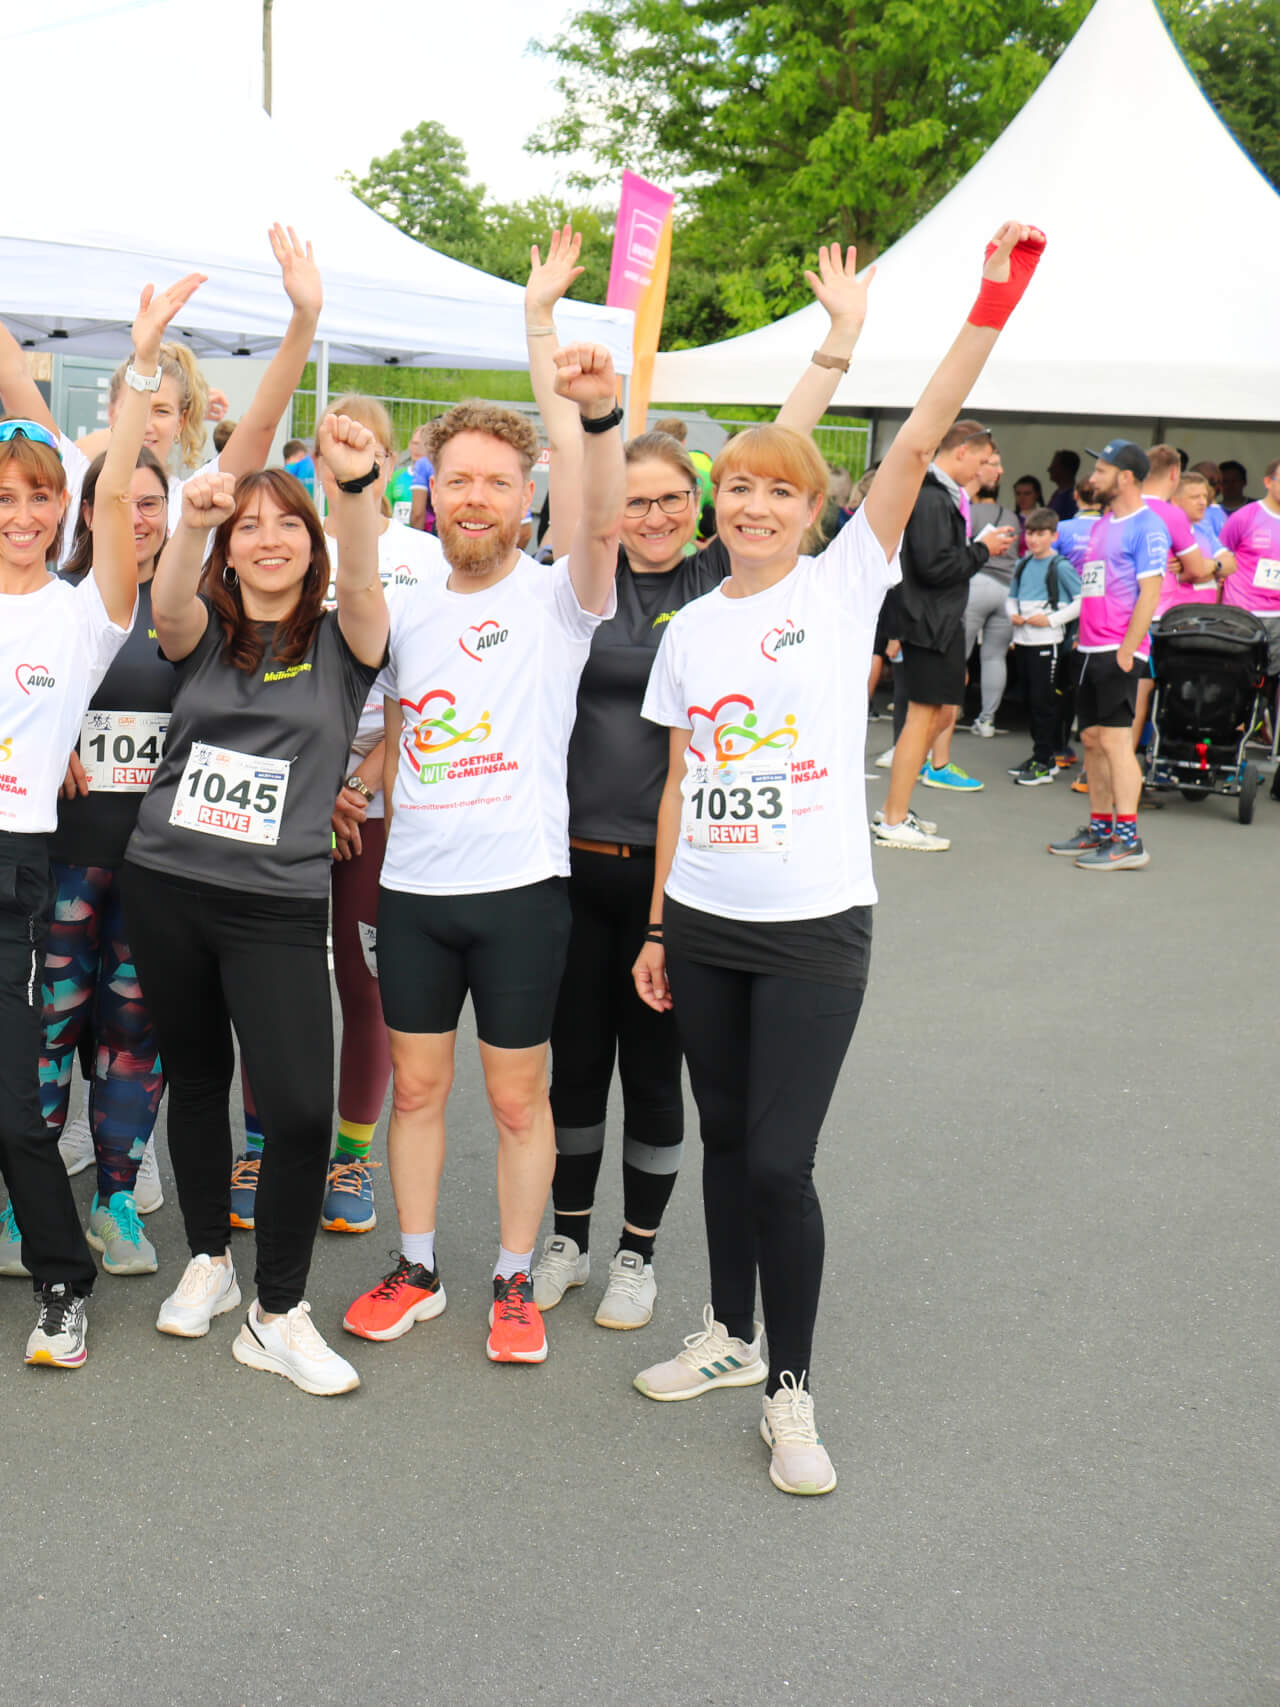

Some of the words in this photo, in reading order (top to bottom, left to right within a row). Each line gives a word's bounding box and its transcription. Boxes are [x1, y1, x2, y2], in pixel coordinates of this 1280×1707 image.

[476, 628, 509, 651] AWO
[27, 674, 55, 688] AWO
[88, 733, 169, 763] 104
[449, 752, 504, 768] oGETHER
[188, 768, 279, 815] 1045
[691, 786, 784, 820] 1033
[199, 805, 250, 832] REWE
[709, 825, 759, 843] REWE
